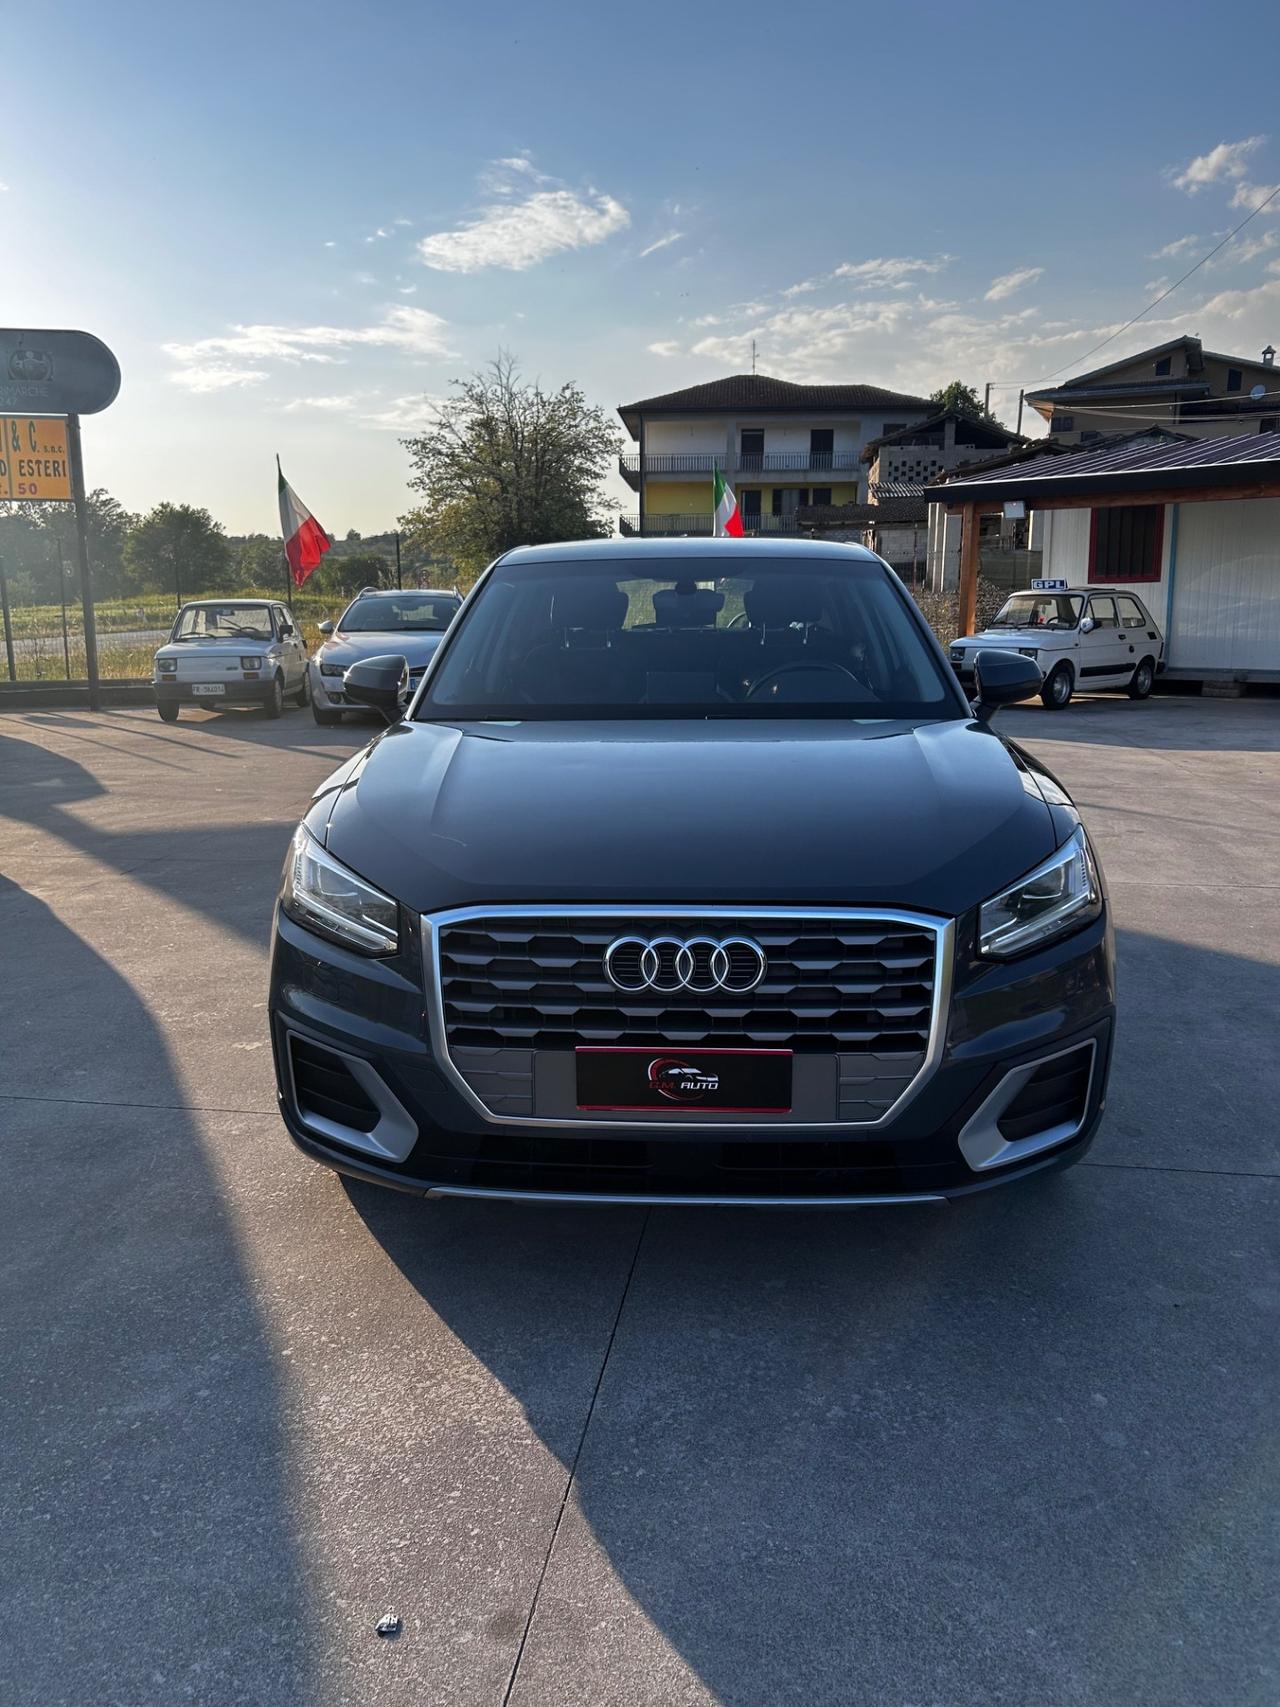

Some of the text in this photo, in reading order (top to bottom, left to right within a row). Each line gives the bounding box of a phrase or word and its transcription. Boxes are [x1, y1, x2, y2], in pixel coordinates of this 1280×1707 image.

[12, 420, 21, 452] &
[19, 459, 67, 478] ESTERI
[18, 482, 38, 495] 50
[1033, 580, 1064, 589] GPL
[680, 1081, 719, 1090] AUTO
